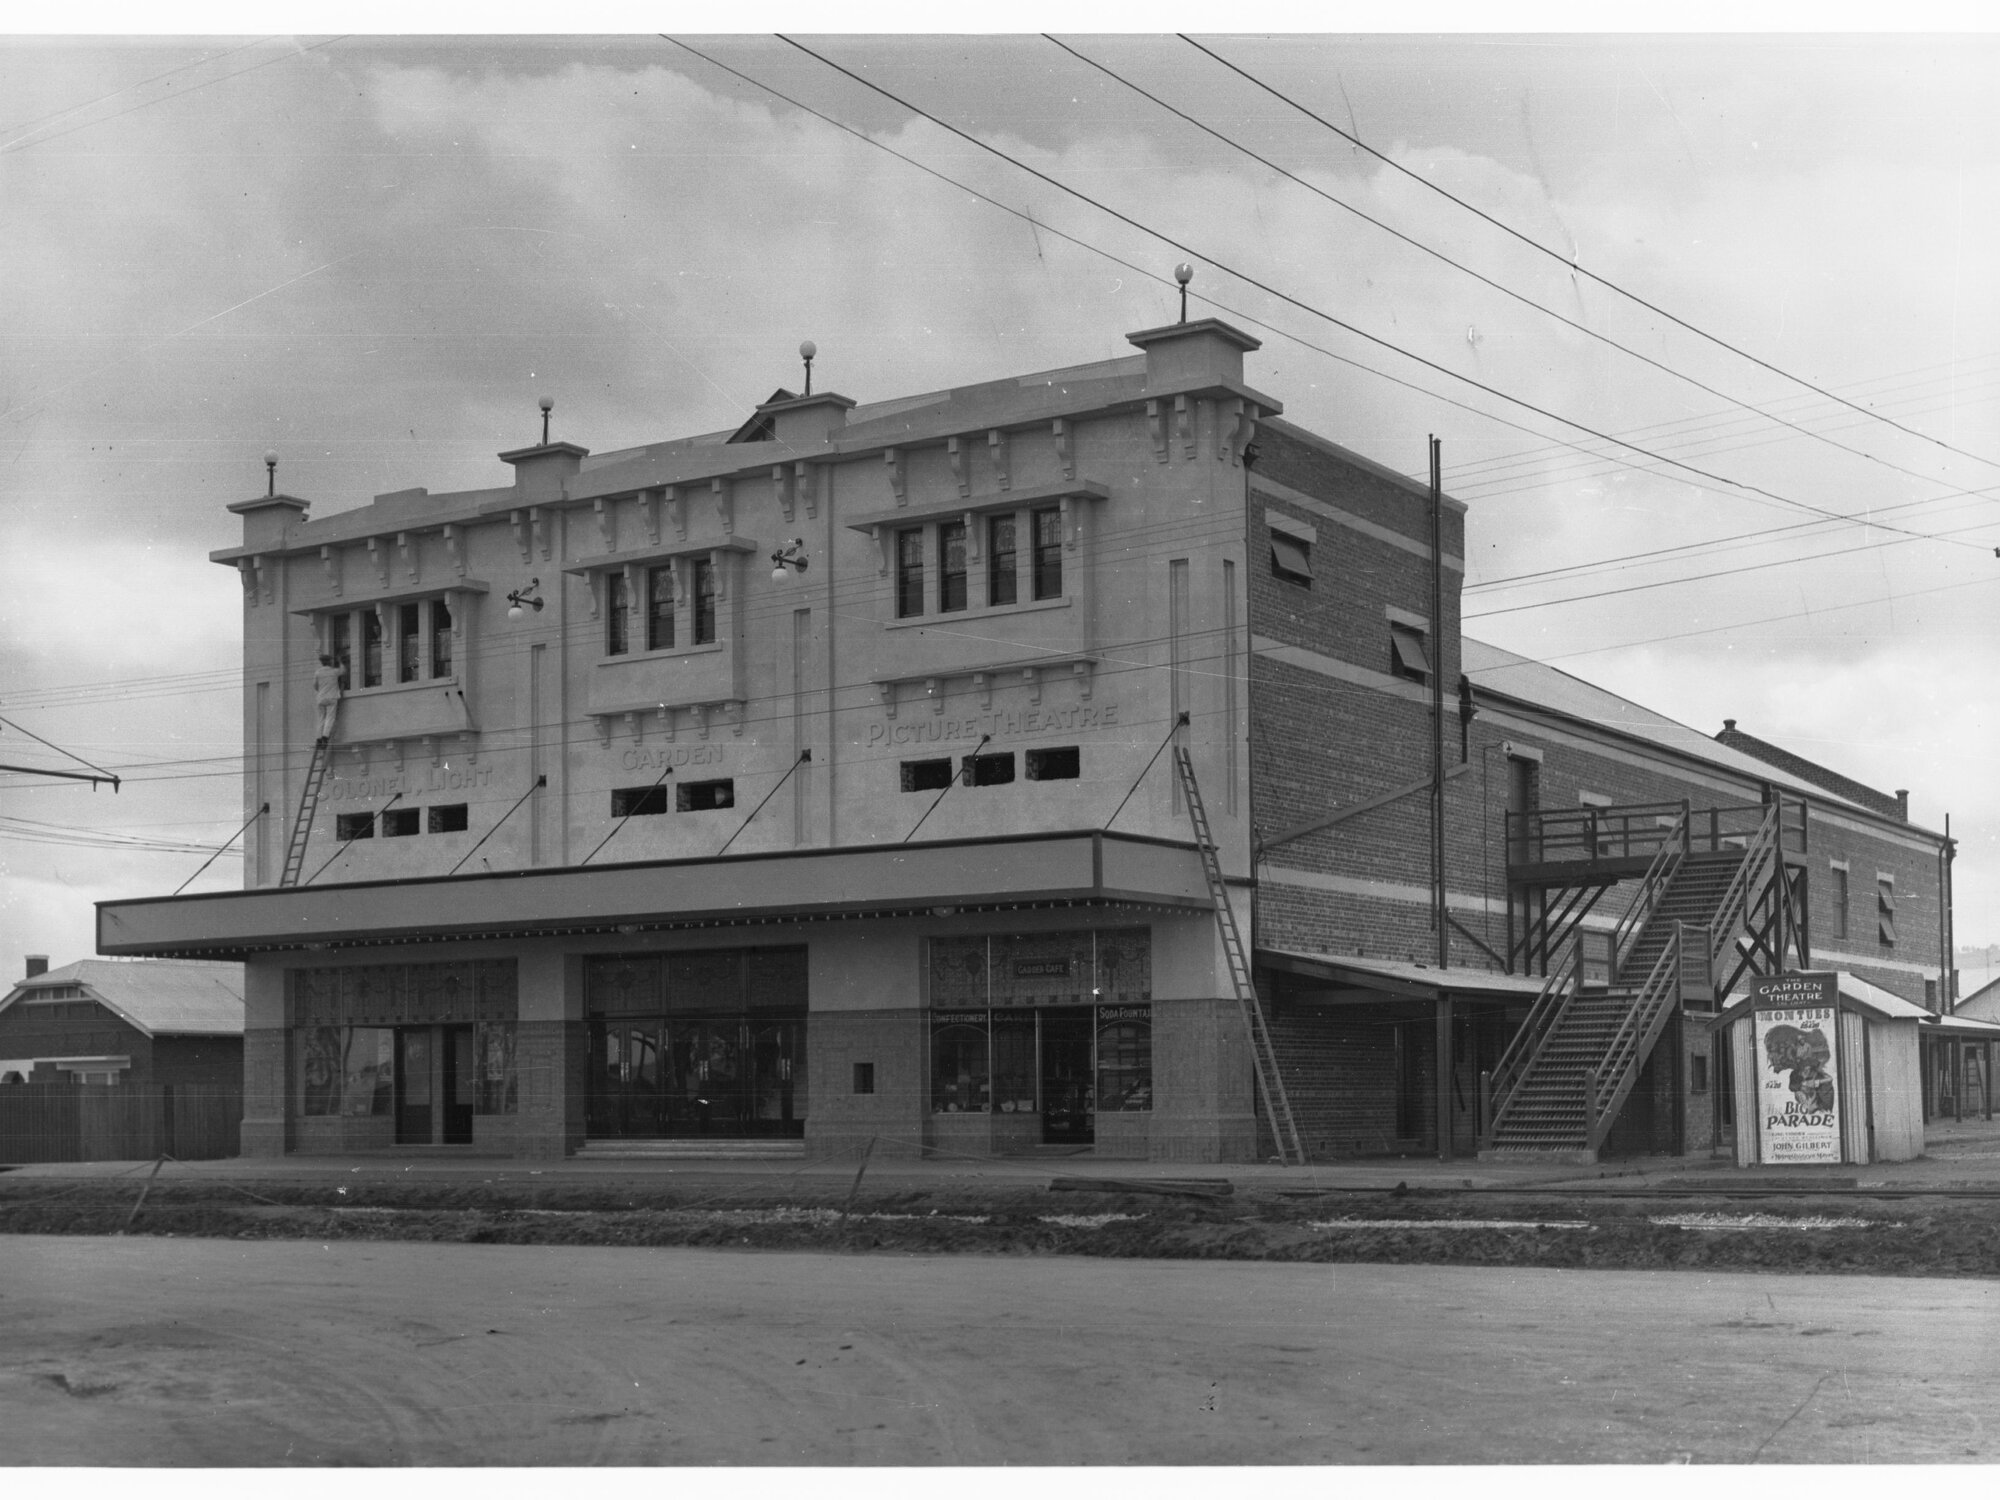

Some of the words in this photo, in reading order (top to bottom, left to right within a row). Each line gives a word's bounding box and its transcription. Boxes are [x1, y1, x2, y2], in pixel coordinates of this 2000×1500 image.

[867, 717, 977, 747] PICTURE
[983, 704, 1118, 736] THEATRE
[622, 743, 723, 771] GARDEN
[426, 766, 493, 792] LIGHT
[1759, 982, 1822, 995] GARDEN
[1767, 992, 1823, 1002] THEATRE
[1119, 1006, 1151, 1019] FOUNTAI
[1796, 1009, 1831, 1020] TUES
[1784, 1101, 1809, 1115] BIG
[1766, 1114, 1835, 1130] PARADE
[1773, 1142, 1794, 1152] JOHN
[1795, 1141, 1833, 1151] GILBERT
